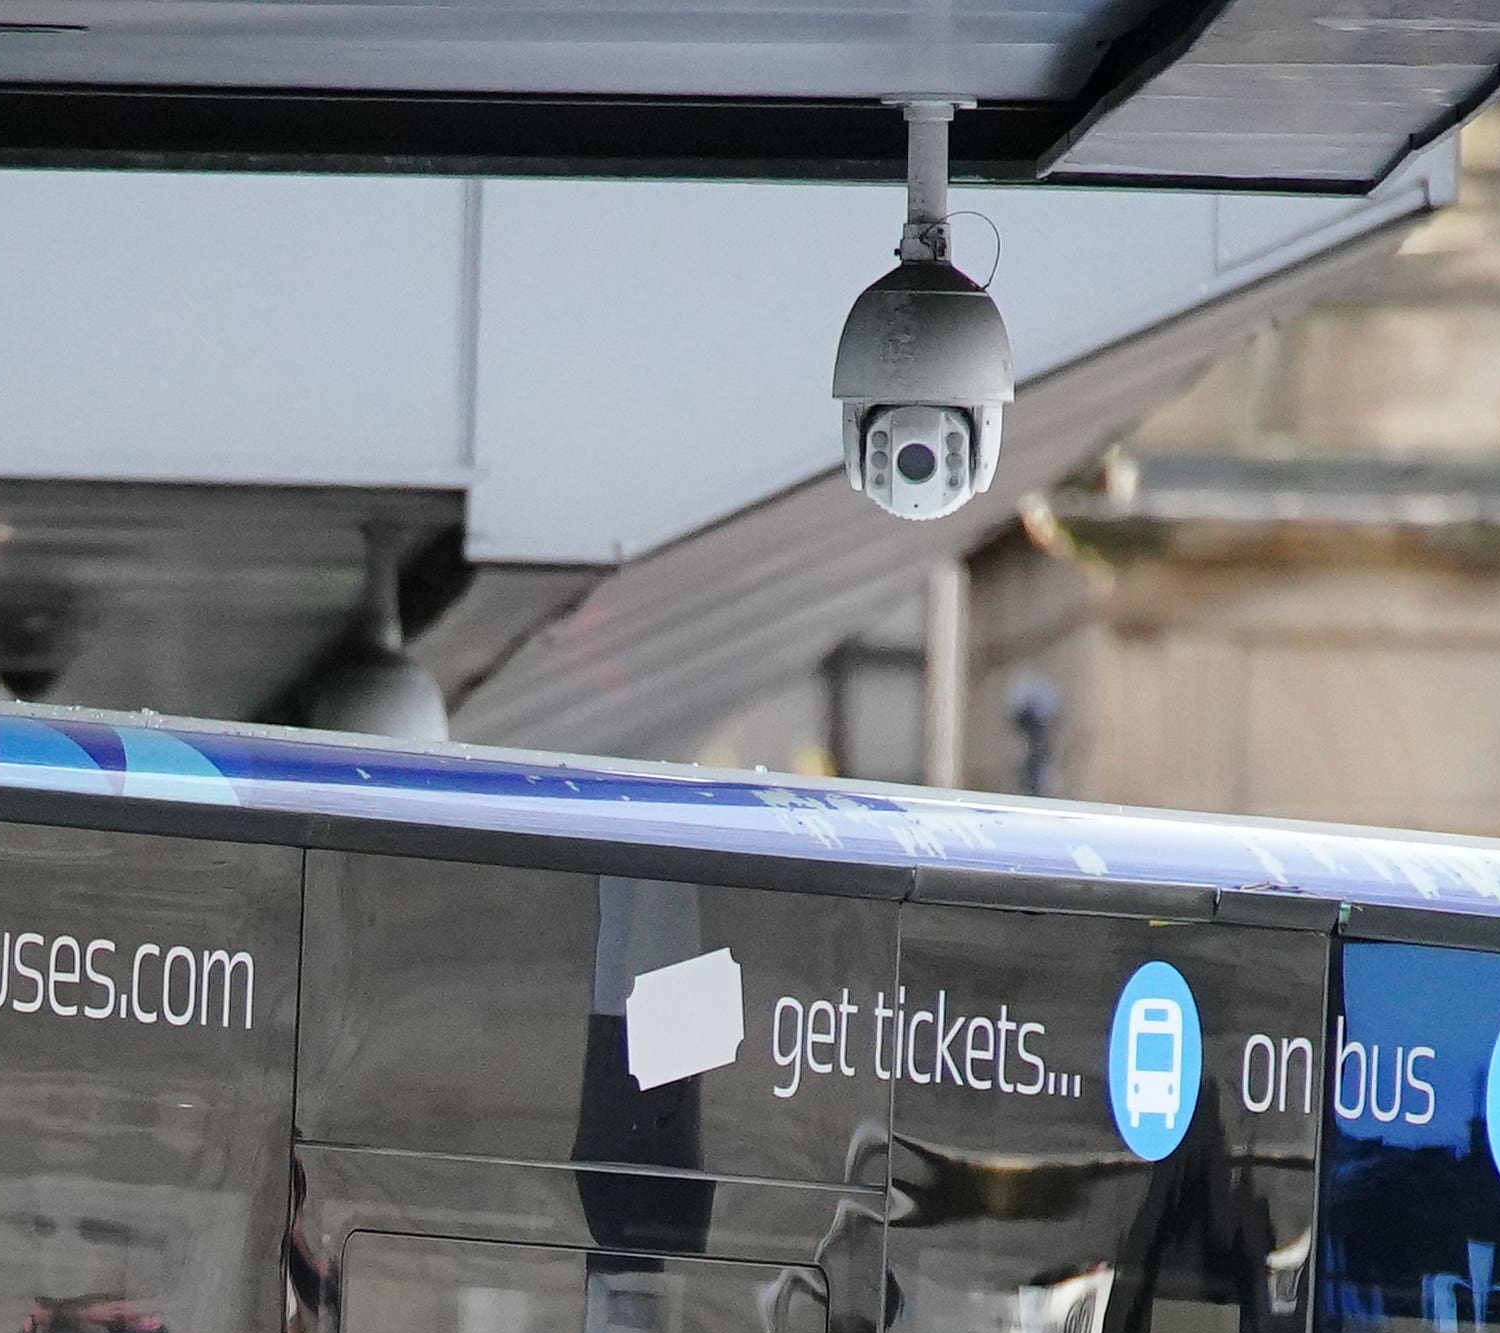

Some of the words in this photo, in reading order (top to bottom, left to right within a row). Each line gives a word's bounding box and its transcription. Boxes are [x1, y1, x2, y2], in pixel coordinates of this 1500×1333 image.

[772, 987, 860, 1098] get
[873, 985, 1083, 1098] tickets...
[1241, 1033, 1314, 1115] on
[1332, 1014, 1436, 1126] bus
